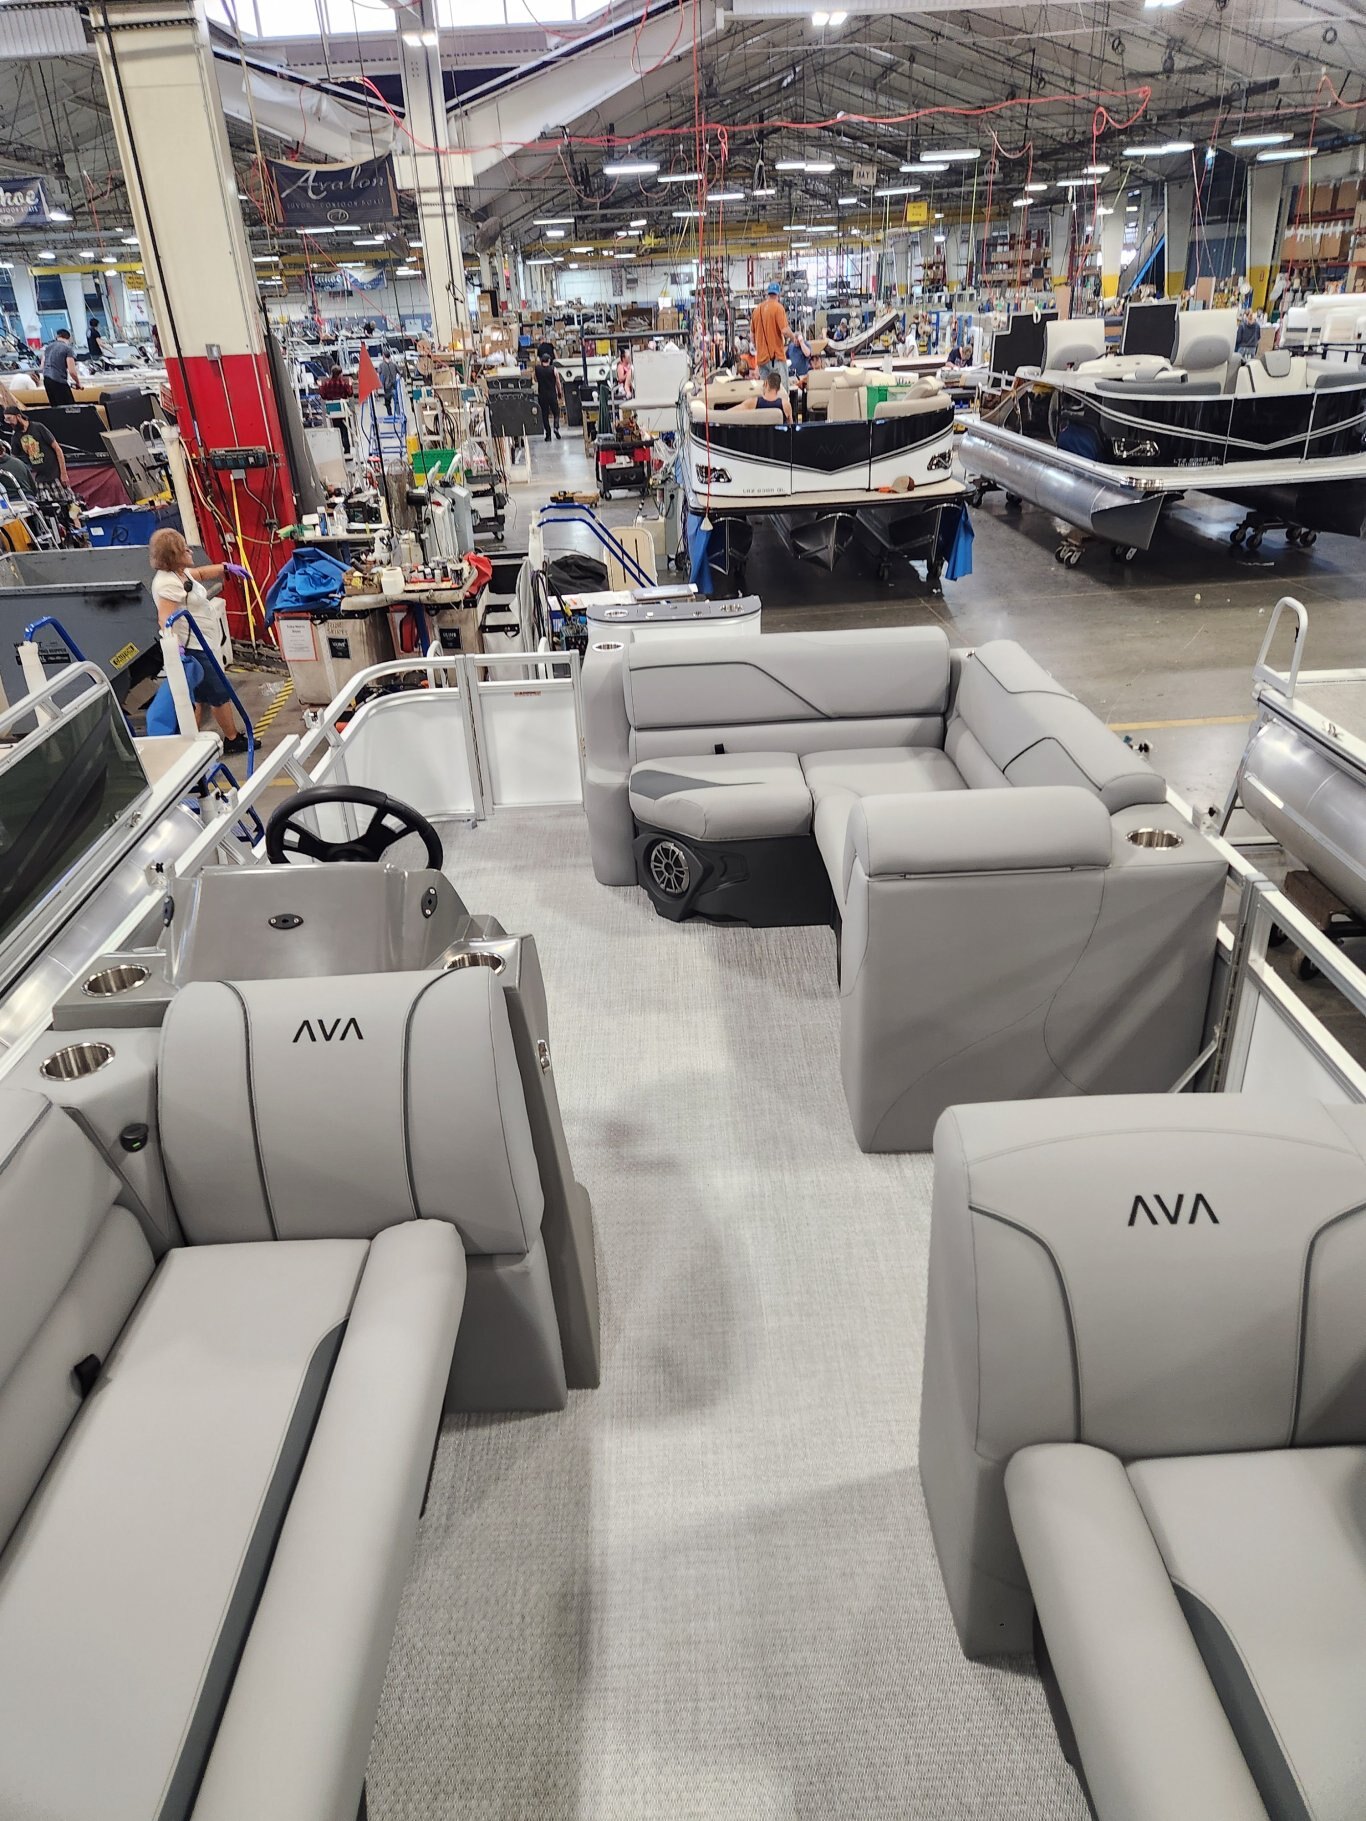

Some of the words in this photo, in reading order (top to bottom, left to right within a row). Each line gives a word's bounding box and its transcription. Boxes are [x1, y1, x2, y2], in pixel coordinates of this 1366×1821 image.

[281, 165, 384, 200] Avalon
[292, 1017, 364, 1043] AVA
[1127, 1193, 1220, 1227] AVA
